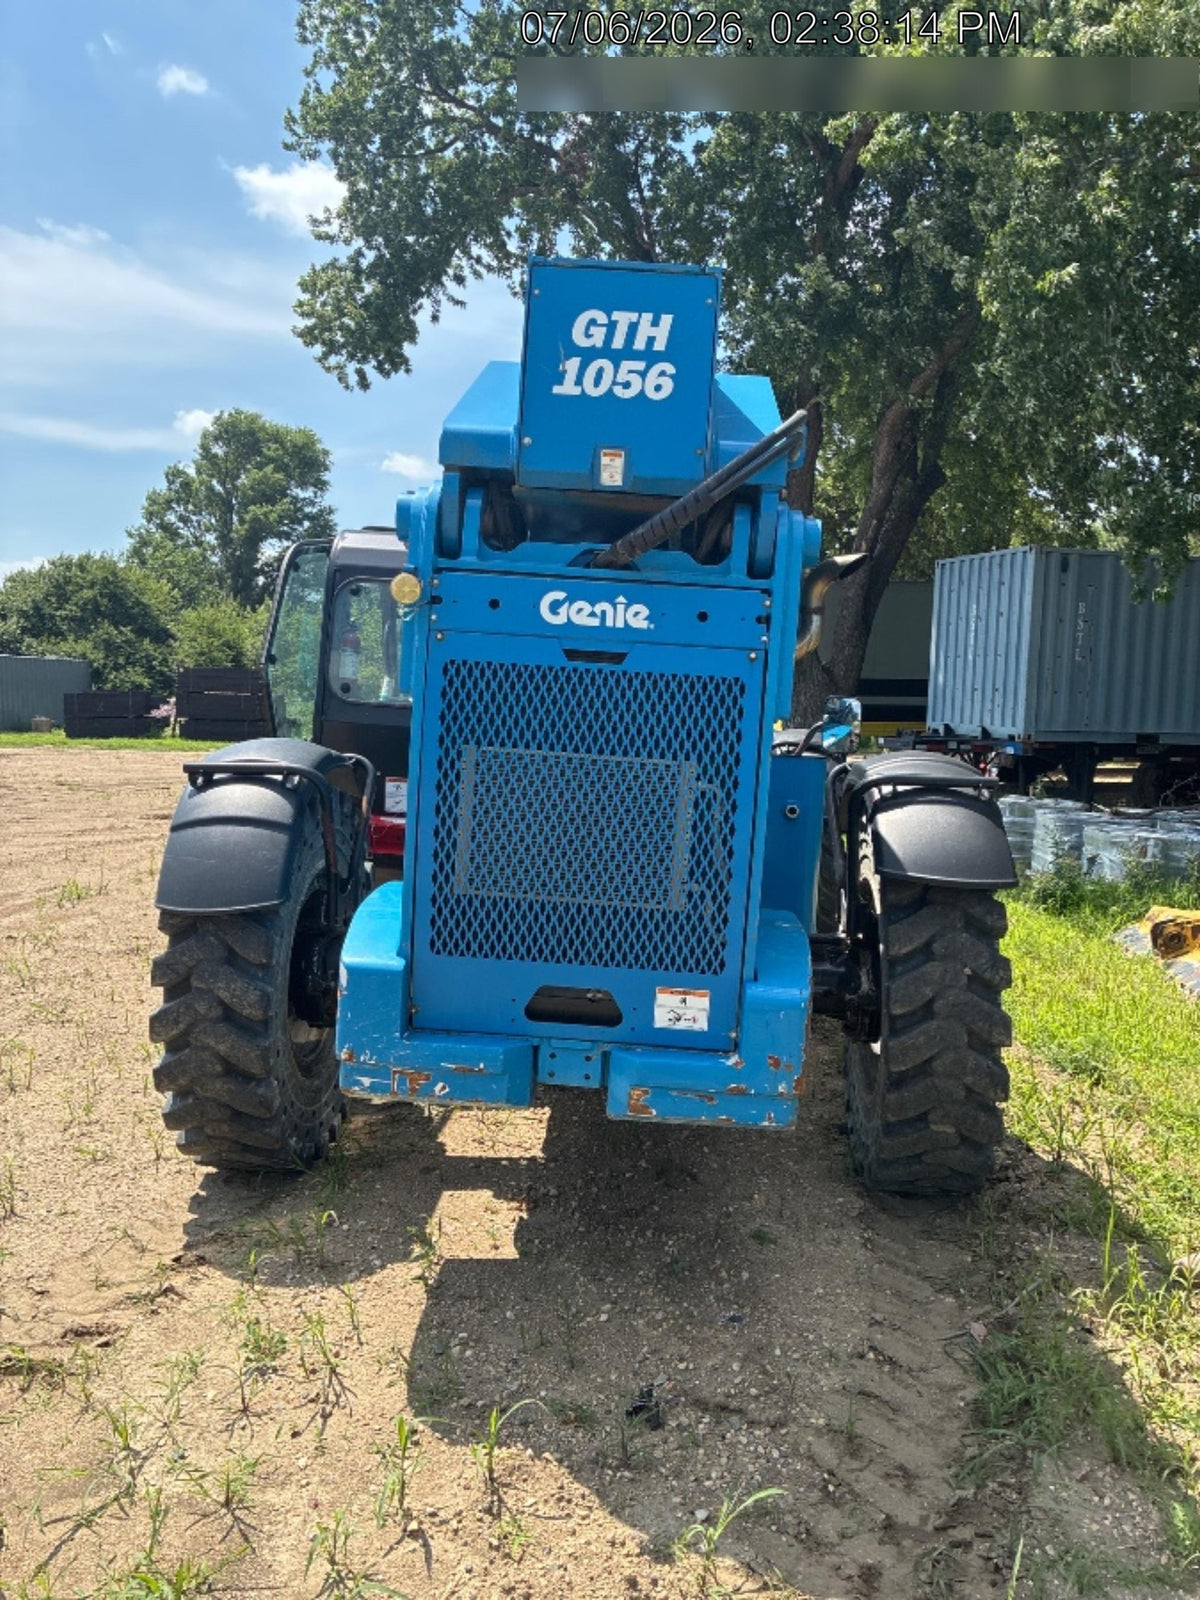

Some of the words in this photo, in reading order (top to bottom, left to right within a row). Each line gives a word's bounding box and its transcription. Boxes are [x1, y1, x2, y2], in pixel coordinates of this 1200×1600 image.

[572, 309, 674, 351] GTH
[552, 357, 677, 401] 1056
[540, 590, 652, 629] Genie
